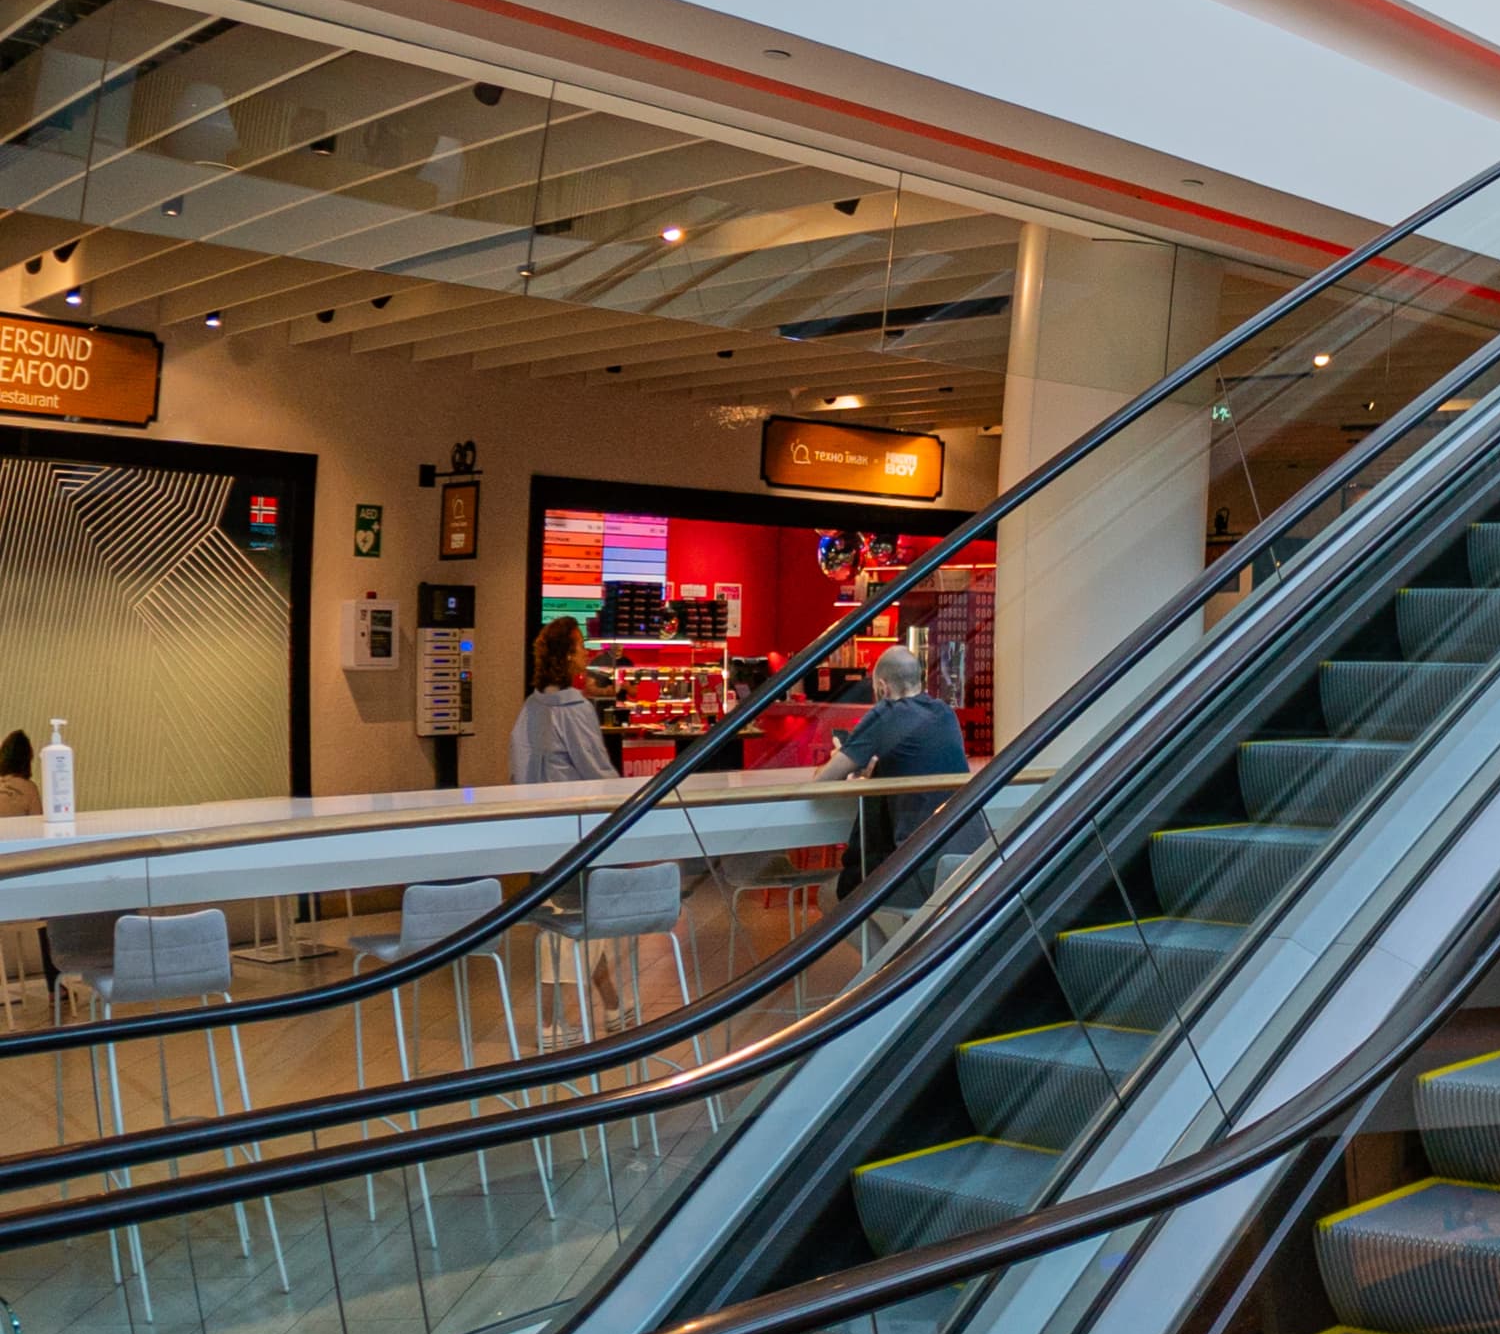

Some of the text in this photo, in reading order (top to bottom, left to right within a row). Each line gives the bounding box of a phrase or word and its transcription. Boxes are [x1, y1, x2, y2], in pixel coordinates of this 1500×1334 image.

[1, 326, 92, 361] ERSUND
[0, 357, 89, 391] EAFOOD
[0, 389, 60, 409] estaurant
[884, 464, 917, 476] BOY
